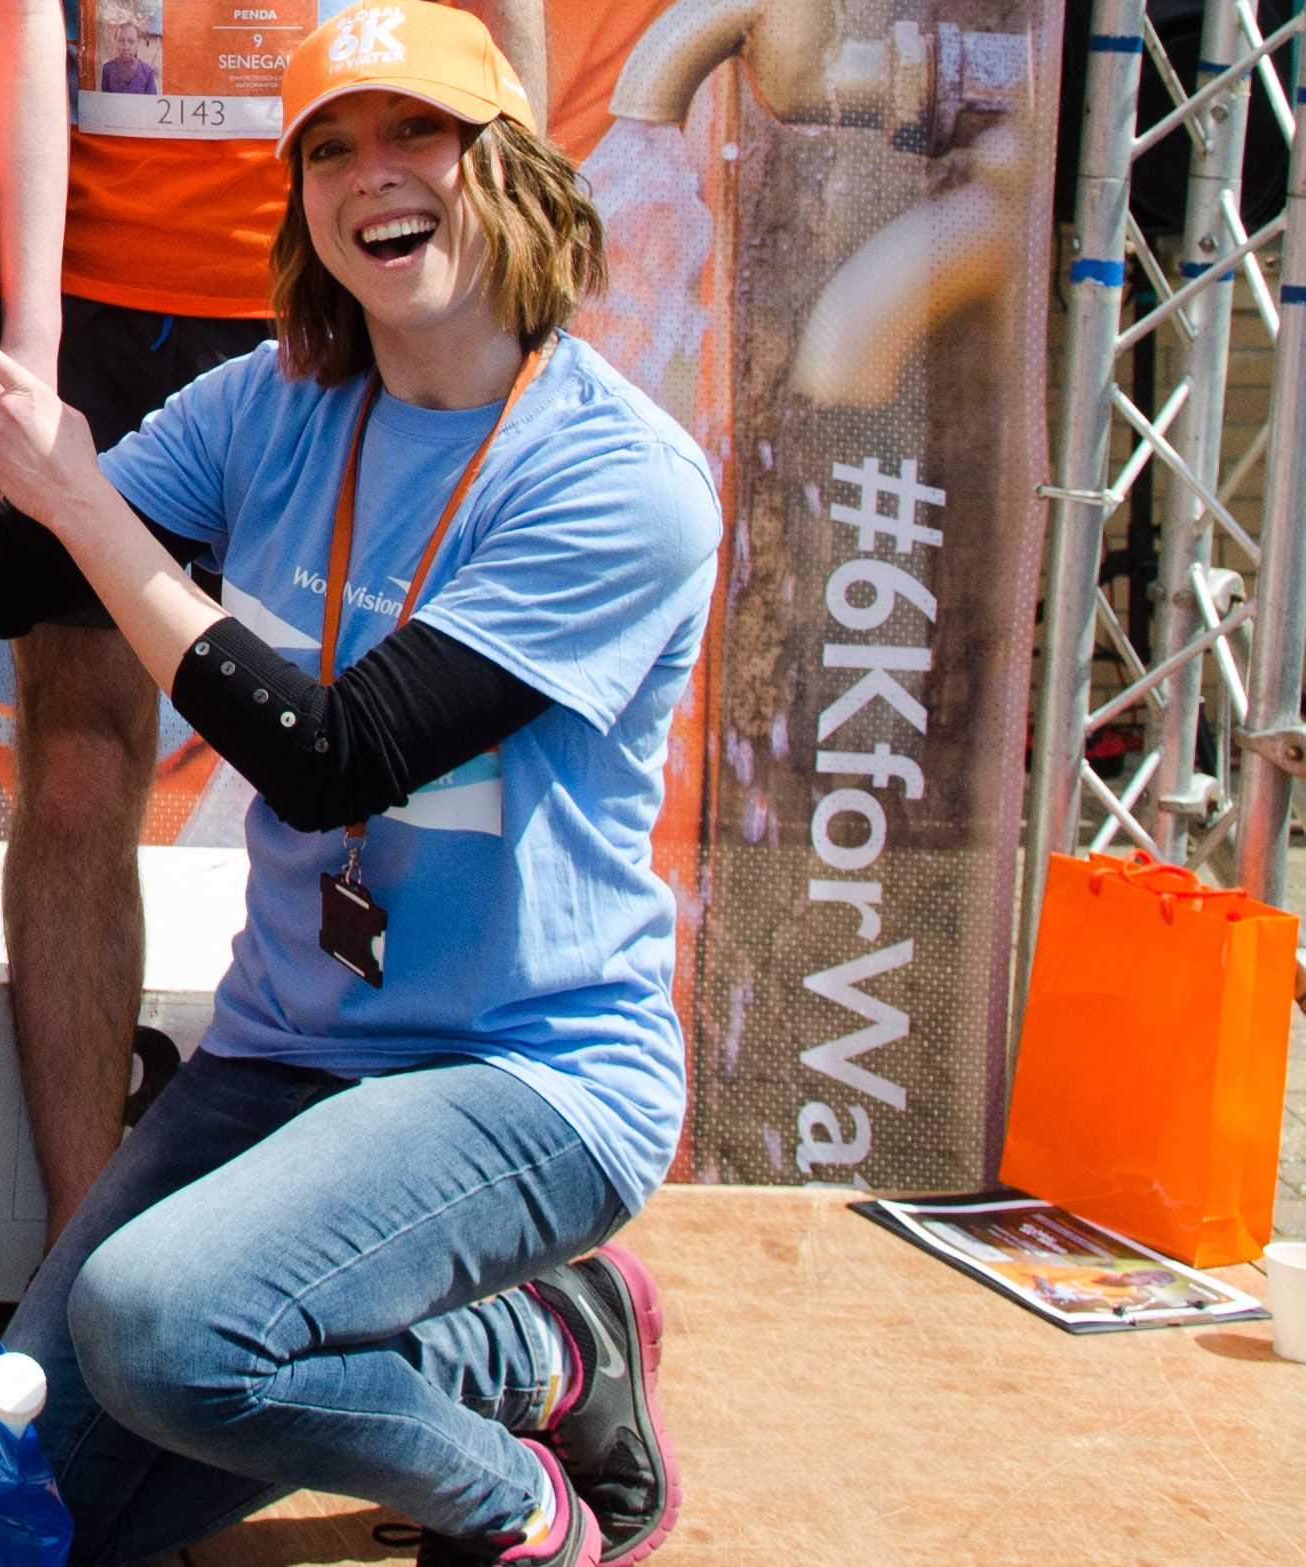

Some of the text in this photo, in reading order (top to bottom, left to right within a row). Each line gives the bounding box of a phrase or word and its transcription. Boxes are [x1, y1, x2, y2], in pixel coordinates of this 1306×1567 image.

[233, 9, 277, 20] PENDA
[253, 33, 263, 48] 9
[329, 18, 405, 62] 6K
[157, 99, 226, 127] 2143
[343, 579, 404, 618] Vision
[796, 457, 947, 1180] #6KforWa
